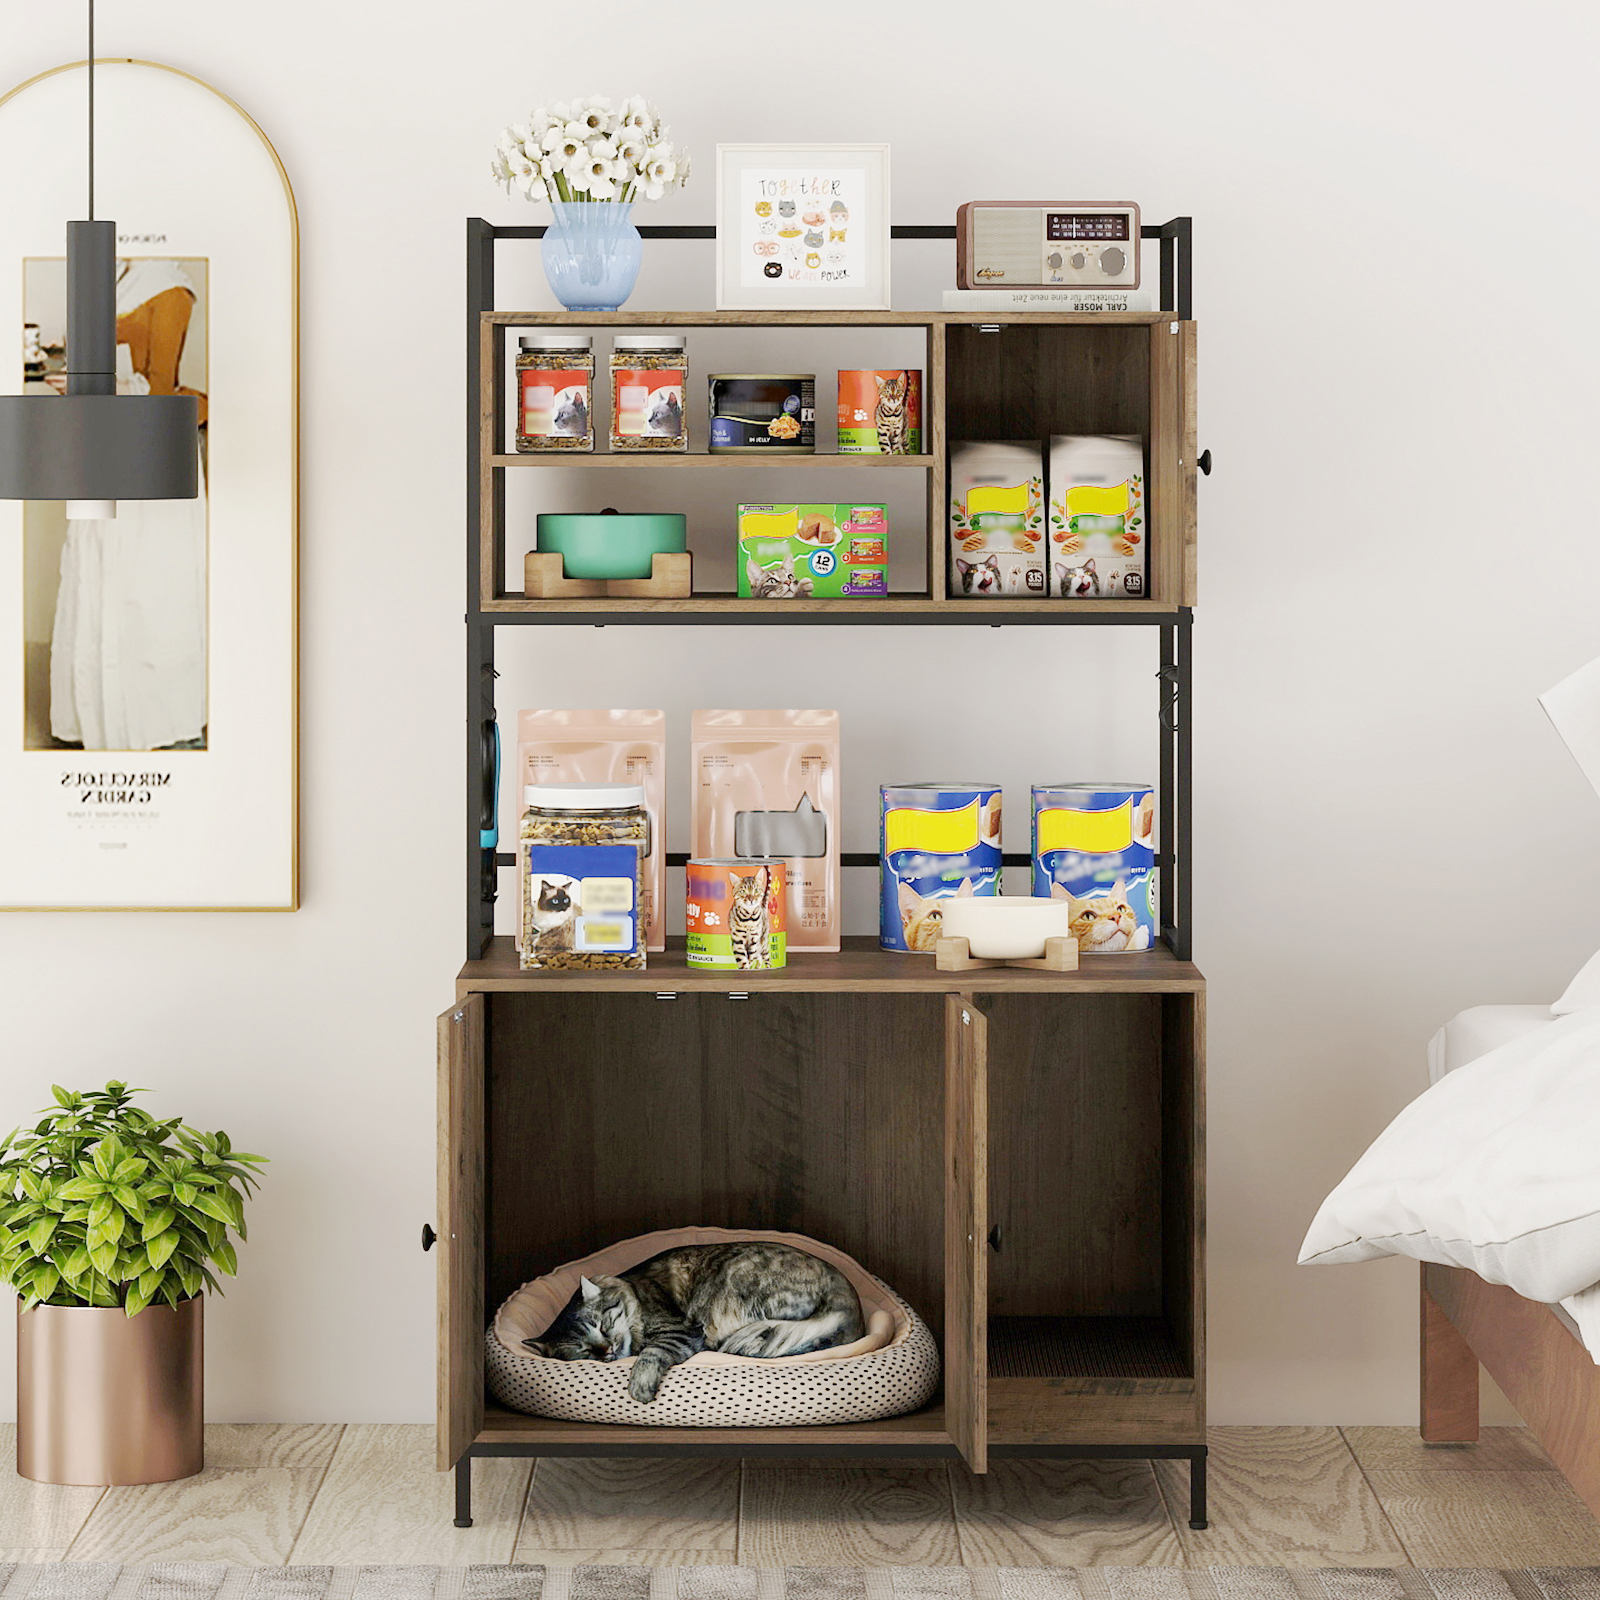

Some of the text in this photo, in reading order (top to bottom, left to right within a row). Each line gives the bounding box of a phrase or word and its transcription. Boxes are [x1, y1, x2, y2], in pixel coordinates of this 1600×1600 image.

[1012, 294, 1028, 303] Zeit
[1051, 294, 1068, 302] eine
[1083, 294, 1128, 303] Architektur
[1073, 303, 1128, 311] CARL MOSER
[816, 555, 831, 566] 12
[1125, 575, 1141, 587] 3.15
